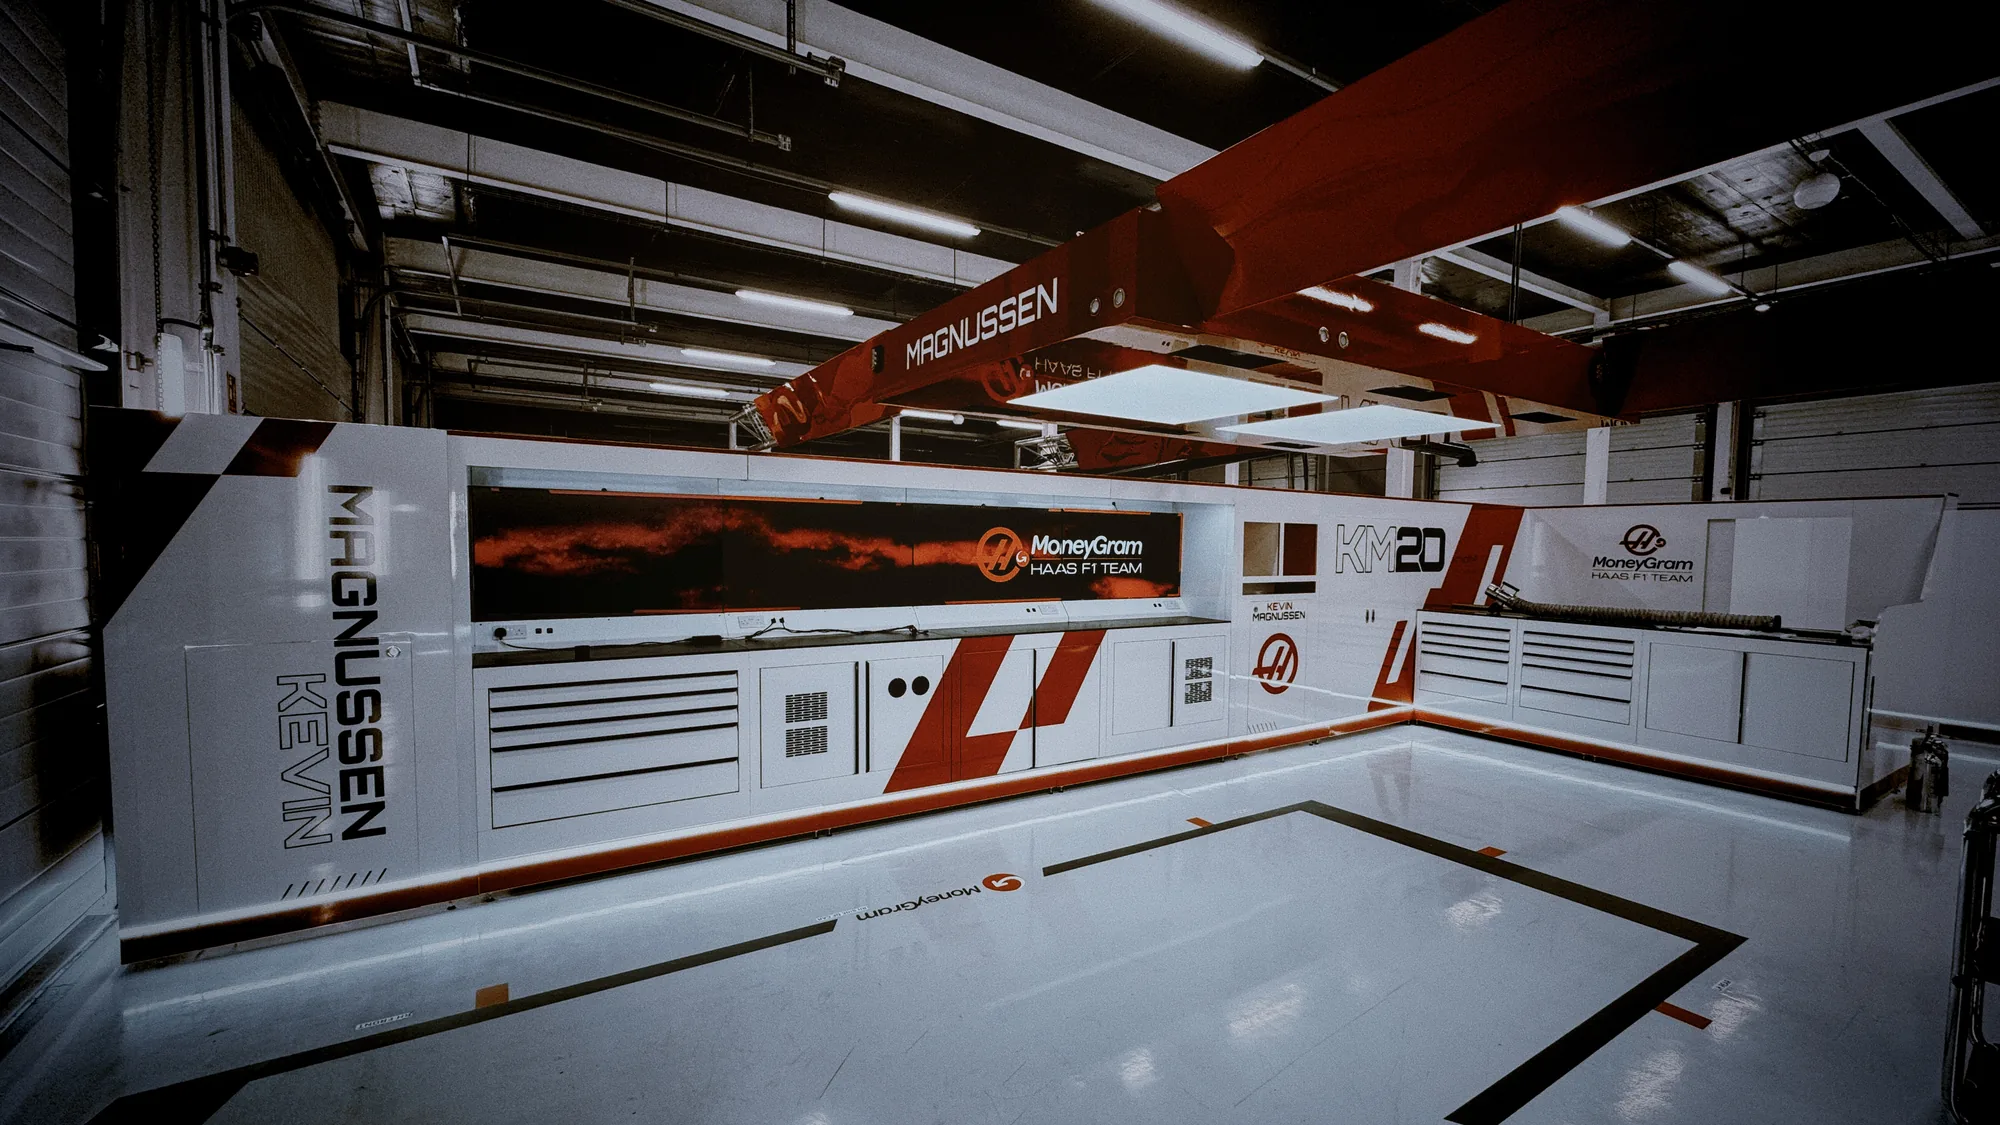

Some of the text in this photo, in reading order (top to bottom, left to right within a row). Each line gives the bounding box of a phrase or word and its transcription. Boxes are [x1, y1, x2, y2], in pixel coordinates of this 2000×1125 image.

[905, 277, 1059, 371] MAGNUSSEN
[1031, 534, 1143, 560] MoneyGram
[1335, 523, 1447, 574] KM20
[1030, 562, 1143, 575] HAAS F1 TEAM
[1592, 556, 1694, 571] MoneyGram
[1591, 572, 1694, 583] HAAS F1 TEAM
[1252, 611, 1305, 621] MAGNUSSEN
[1267, 602, 1292, 610] KEVIN
[327, 485, 387, 841] MAGNUSSEN
[276, 673, 333, 850] KEVIN
[856, 885, 982, 921] MoneyGram
